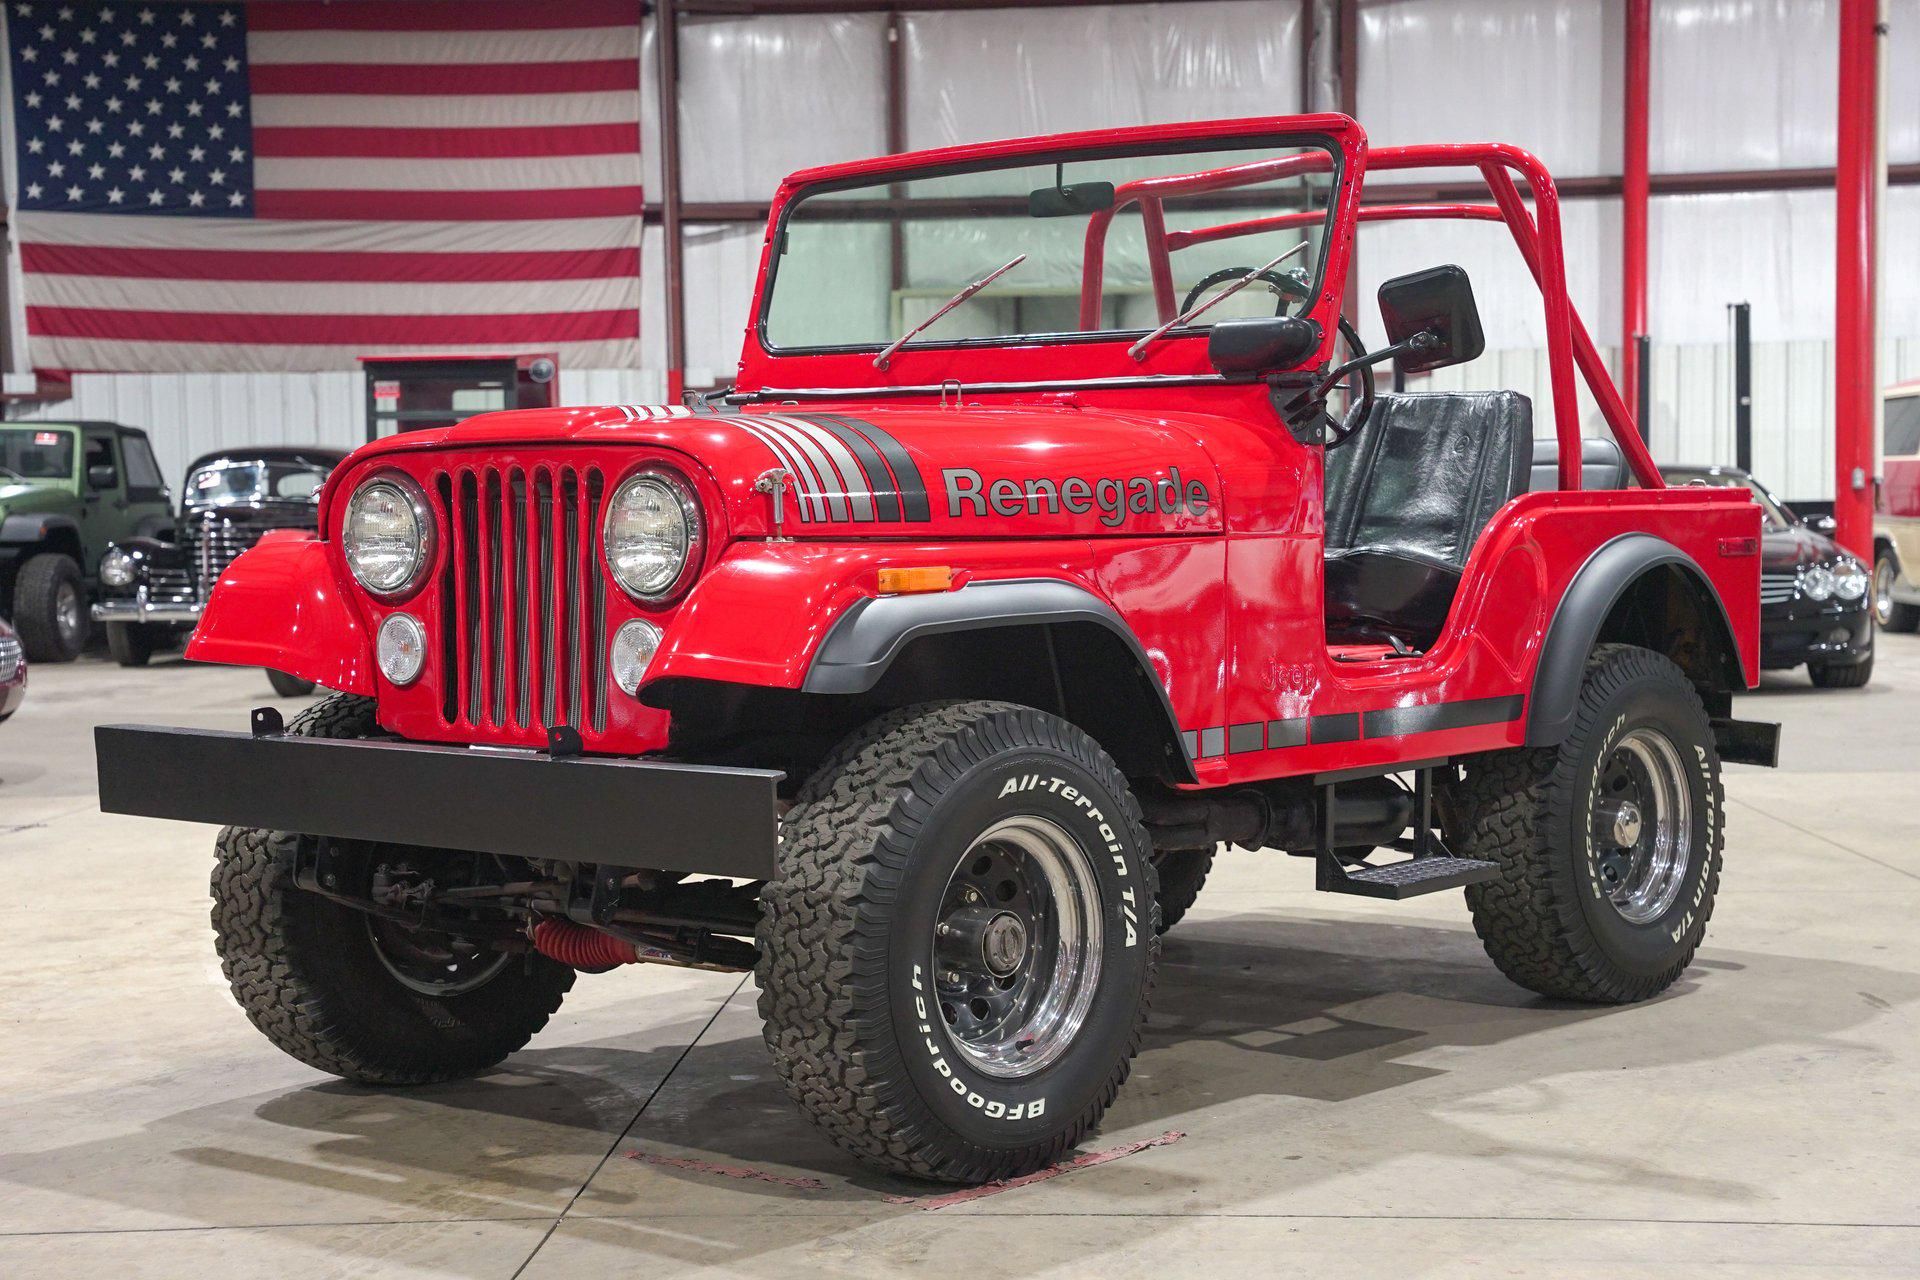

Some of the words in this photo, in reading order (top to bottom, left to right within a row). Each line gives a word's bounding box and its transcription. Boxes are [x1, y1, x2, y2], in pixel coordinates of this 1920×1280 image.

[941, 466, 1209, 527] Renegade
[1261, 657, 1317, 696] Jeep
[997, 774, 1128, 876] All-Terrain
[1122, 886, 1138, 948] T/A
[1586, 712, 1626, 899] BFGoodrich
[1693, 744, 1715, 908] All-Terrain
[1671, 910, 1694, 944] T/A
[912, 964, 1046, 1120] BFGoodrich
